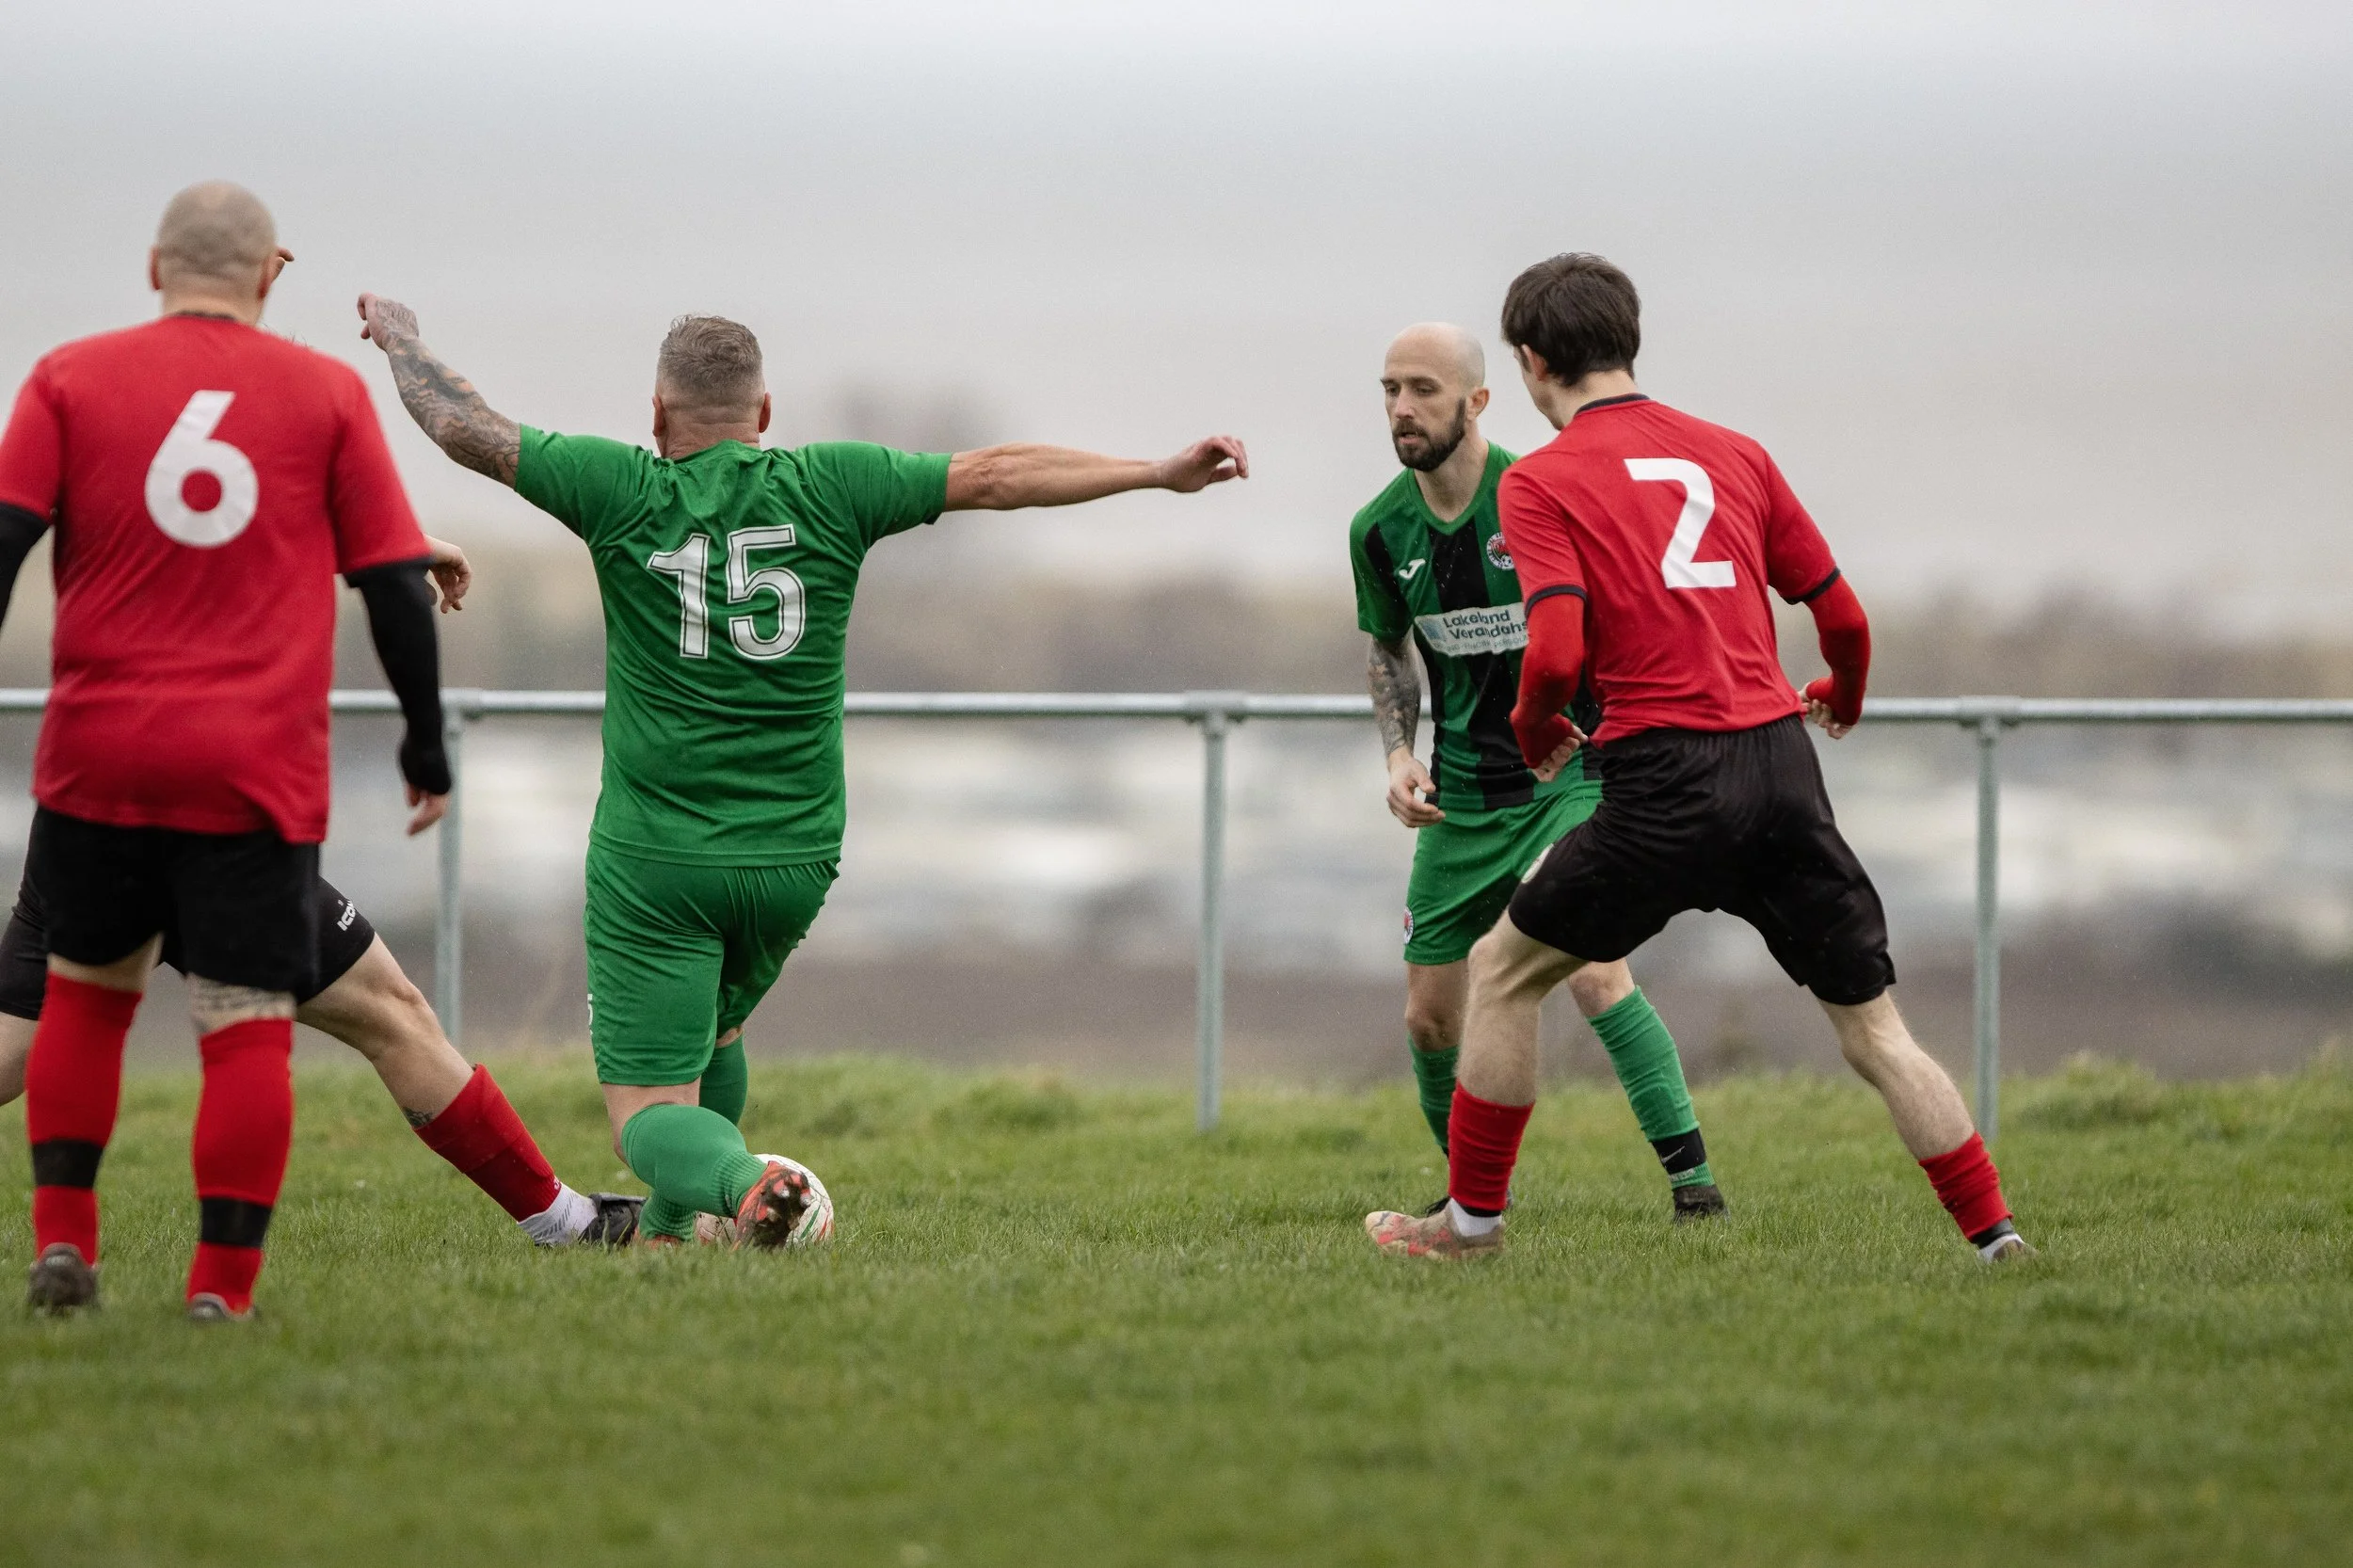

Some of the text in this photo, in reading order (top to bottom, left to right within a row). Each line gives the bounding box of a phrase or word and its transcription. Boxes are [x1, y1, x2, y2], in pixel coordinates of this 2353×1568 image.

[145, 390, 258, 547] 6
[1624, 457, 1737, 589] 2
[647, 523, 807, 661] 15
